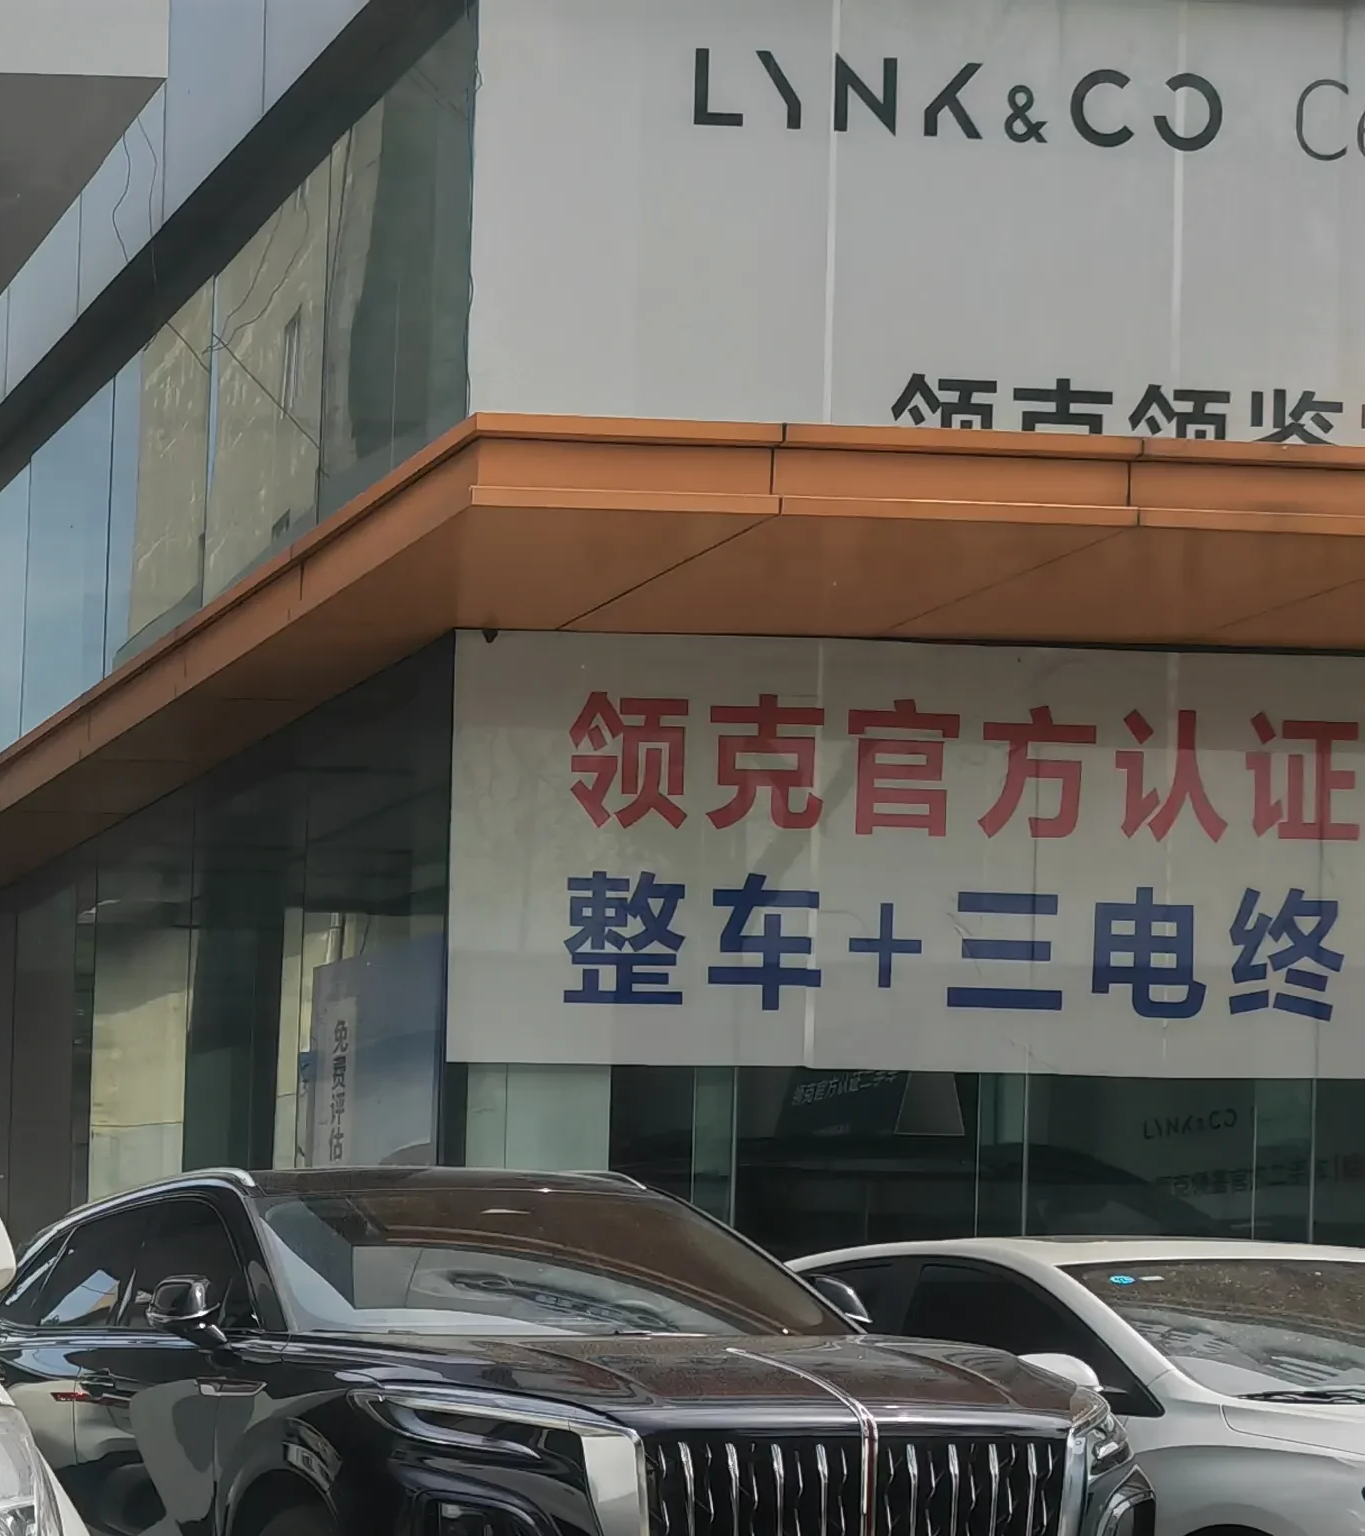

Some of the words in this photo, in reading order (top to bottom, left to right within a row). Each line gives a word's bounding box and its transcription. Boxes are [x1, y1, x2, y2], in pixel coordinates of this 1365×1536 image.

[693, 47, 1224, 152] LYNK&CO
[1295, 78, 1365, 162] C
[890, 372, 1365, 446] 领克领鉴
[569, 690, 1362, 843] 领克官方认证
[563, 870, 1346, 1021] 整车+三电终
